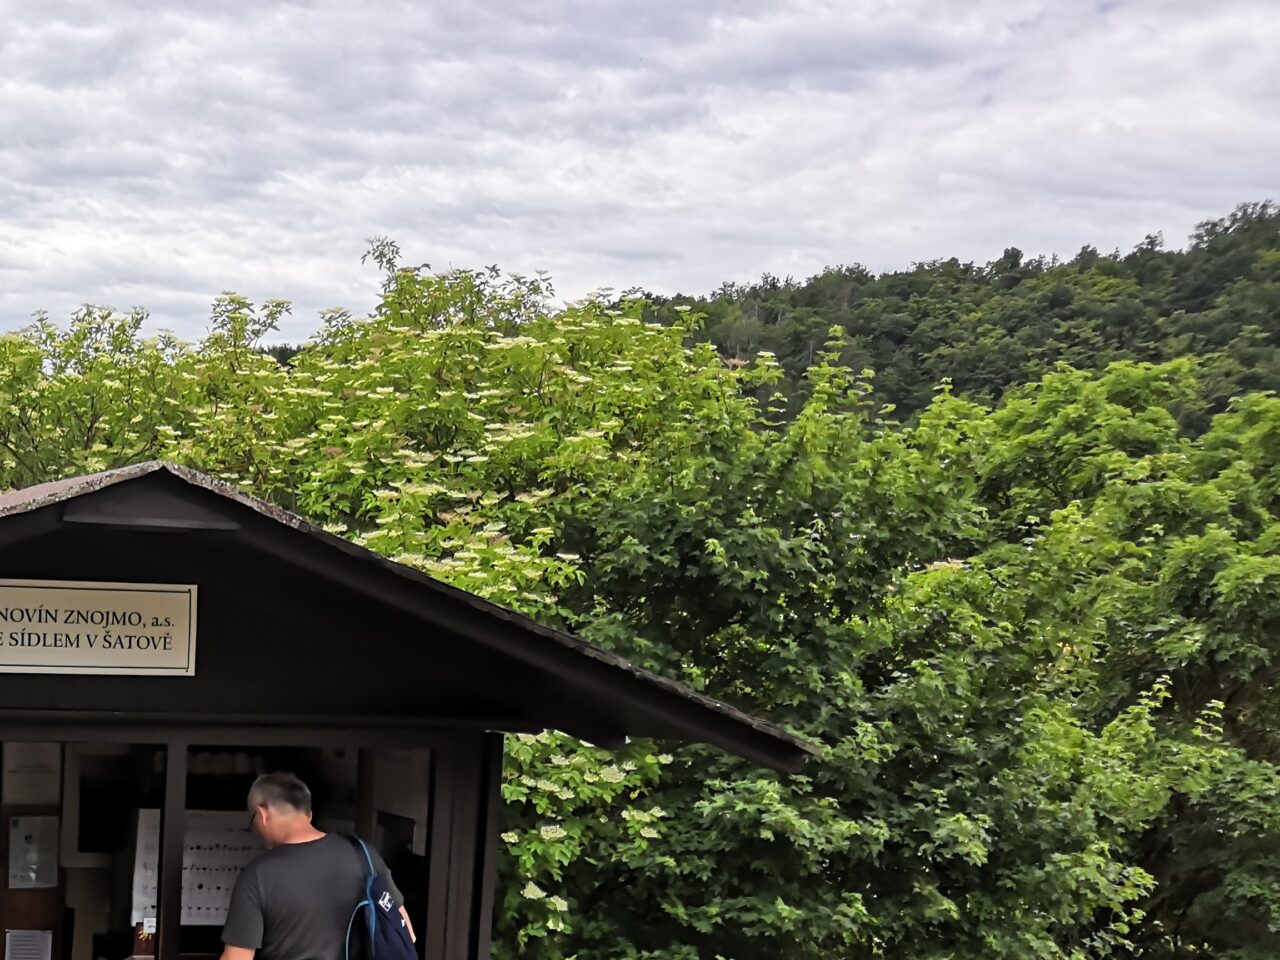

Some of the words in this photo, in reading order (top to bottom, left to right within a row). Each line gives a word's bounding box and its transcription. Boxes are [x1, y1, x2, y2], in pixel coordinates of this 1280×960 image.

[63, 609, 146, 629] ZNOJMO,
[151, 616, 175, 627] a.s.
[8, 627, 80, 648] SÍDLEM
[86, 634, 98, 649] V
[102, 630, 172, 650] ŠATOVĚ
